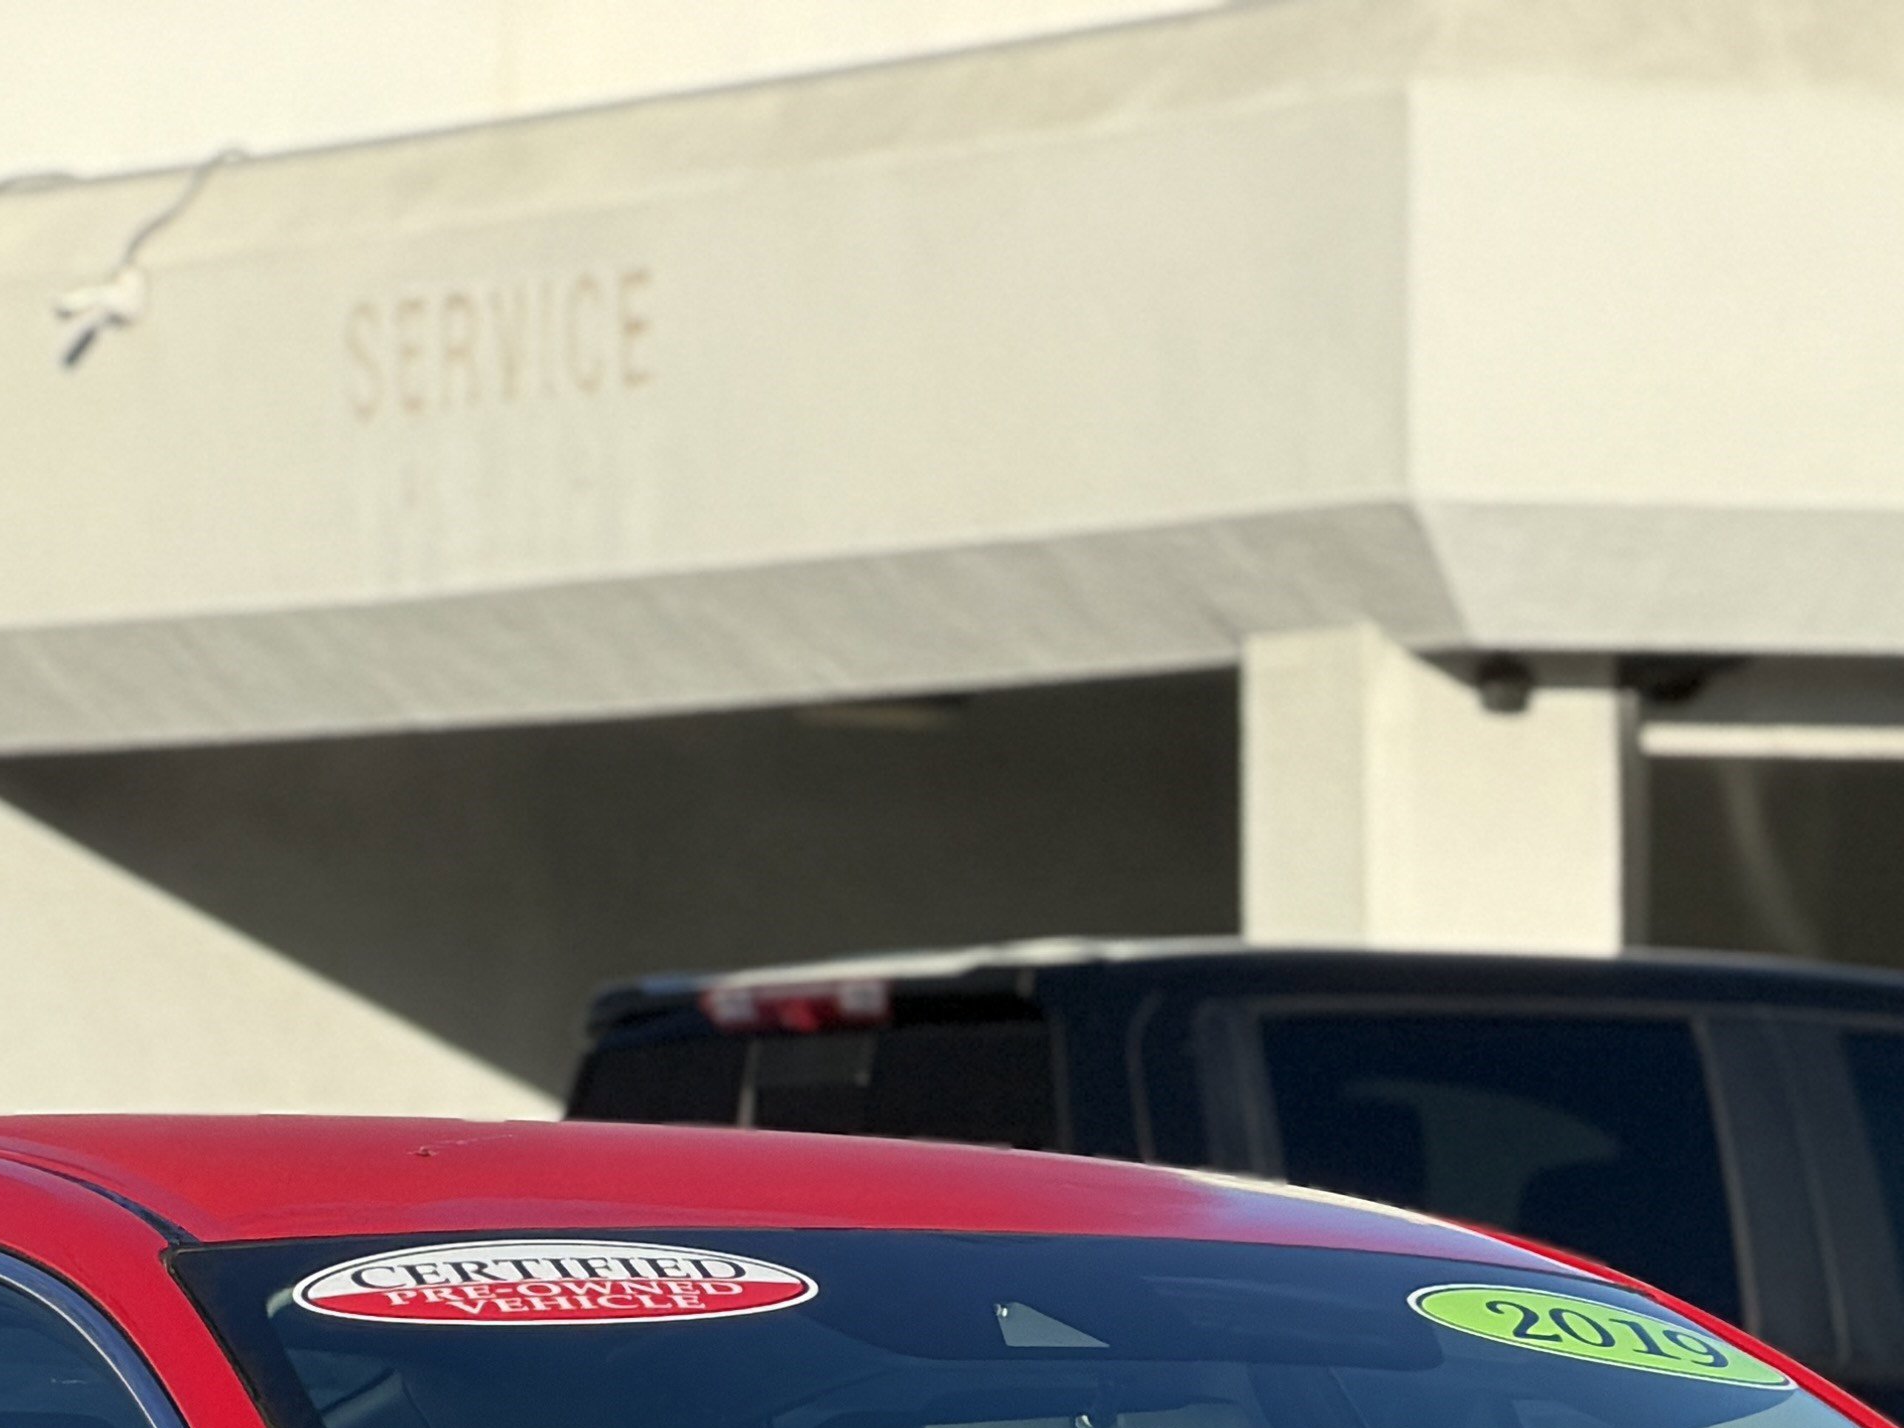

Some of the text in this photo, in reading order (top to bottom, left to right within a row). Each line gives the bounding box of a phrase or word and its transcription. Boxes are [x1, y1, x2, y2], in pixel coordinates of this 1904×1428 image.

[343, 267, 653, 422] SERVICE
[349, 1256, 747, 1290] CERTIFIED
[385, 1277, 744, 1305] PRE-OWNED
[447, 1294, 707, 1315] VEHICLE
[1485, 1299, 1729, 1369] 2019
